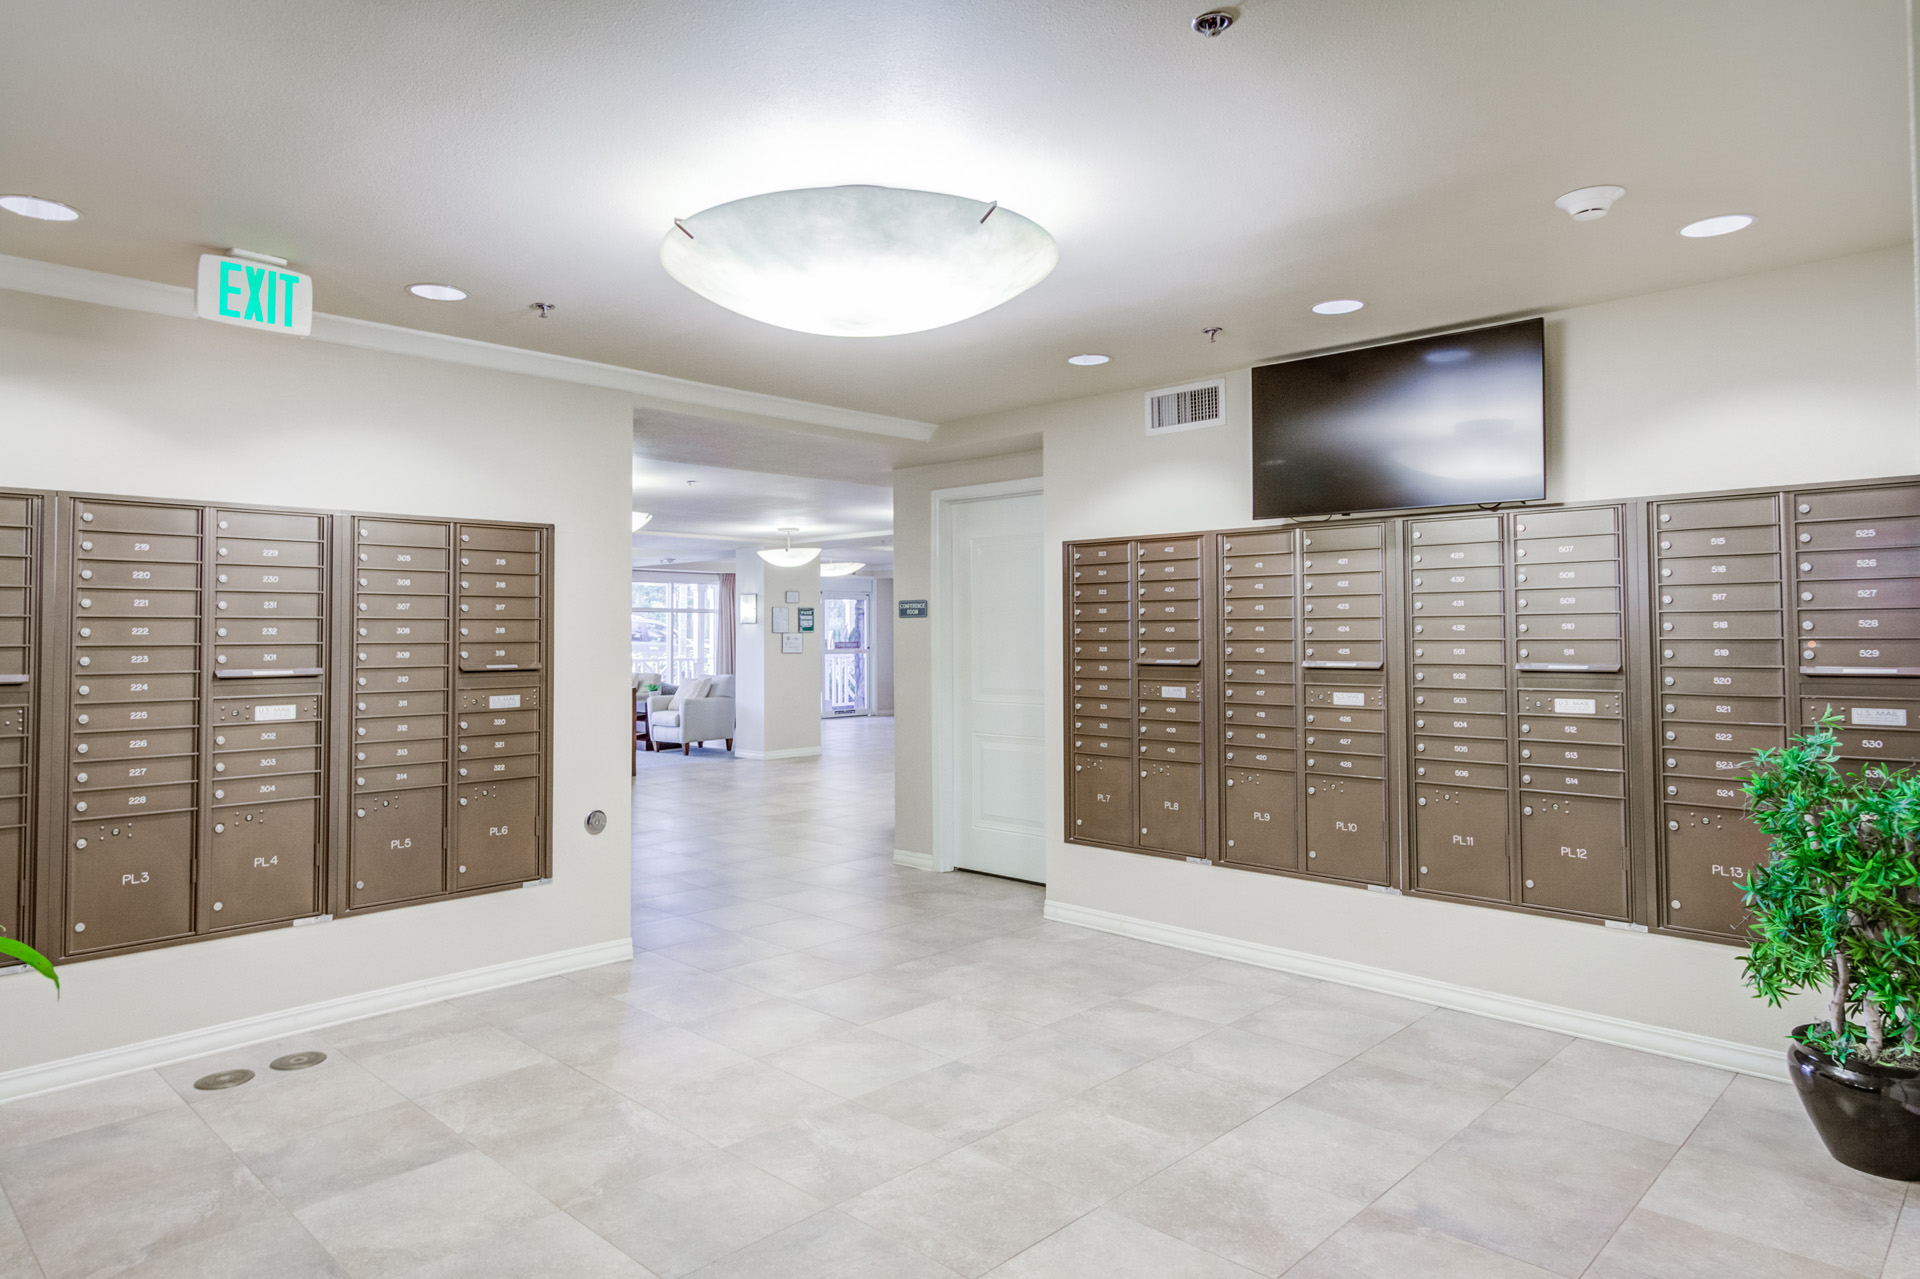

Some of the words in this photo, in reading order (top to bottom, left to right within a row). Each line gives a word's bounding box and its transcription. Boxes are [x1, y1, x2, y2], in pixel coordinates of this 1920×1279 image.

[219, 260, 300, 328] EXIT
[1856, 528, 1876, 538] 525
[1710, 538, 1726, 546] 515
[134, 542, 150, 552] 219
[262, 548, 278, 556] 229
[1856, 558, 1876, 568] 526
[1712, 566, 1726, 574] 516
[132, 570, 150, 580] 220
[1712, 592, 1726, 600] 517
[1856, 590, 1878, 598] 527
[134, 598, 148, 606] 221
[264, 600, 278, 608] 231
[1712, 620, 1728, 628] 518
[1858, 620, 1878, 628] 528
[132, 628, 150, 636] 222
[1714, 648, 1730, 656] 519
[1858, 650, 1880, 658] 529
[130, 656, 148, 664] 223
[262, 654, 276, 662] 301
[1714, 676, 1732, 684] 520
[130, 684, 148, 692] 224
[130, 712, 148, 720] 225
[1564, 726, 1578, 734] 512
[260, 732, 276, 740] 302
[1714, 732, 1732, 742] 522
[130, 740, 148, 748] 226
[1862, 740, 1882, 748] 530
[1564, 752, 1578, 760] 513
[260, 758, 276, 766] 303
[1716, 760, 1734, 770] 523
[128, 768, 146, 776] 227
[494, 764, 506, 772] 322
[396, 772, 408, 780] 314
[1454, 770, 1468, 778] 506
[260, 784, 276, 792] 304
[1716, 788, 1734, 798] 524
[128, 796, 146, 804] 228
[1098, 794, 1110, 802] PL7
[1164, 800, 1178, 810] PL8
[1254, 812, 1270, 822] PL9
[490, 826, 508, 836] PL6
[1336, 822, 1358, 832] PL10
[390, 838, 412, 850] PL5
[1452, 834, 1474, 846] PL11
[1560, 846, 1588, 860] PL12
[254, 856, 278, 868] PL4
[1712, 864, 1744, 878] PL13
[122, 872, 150, 886] PL3
